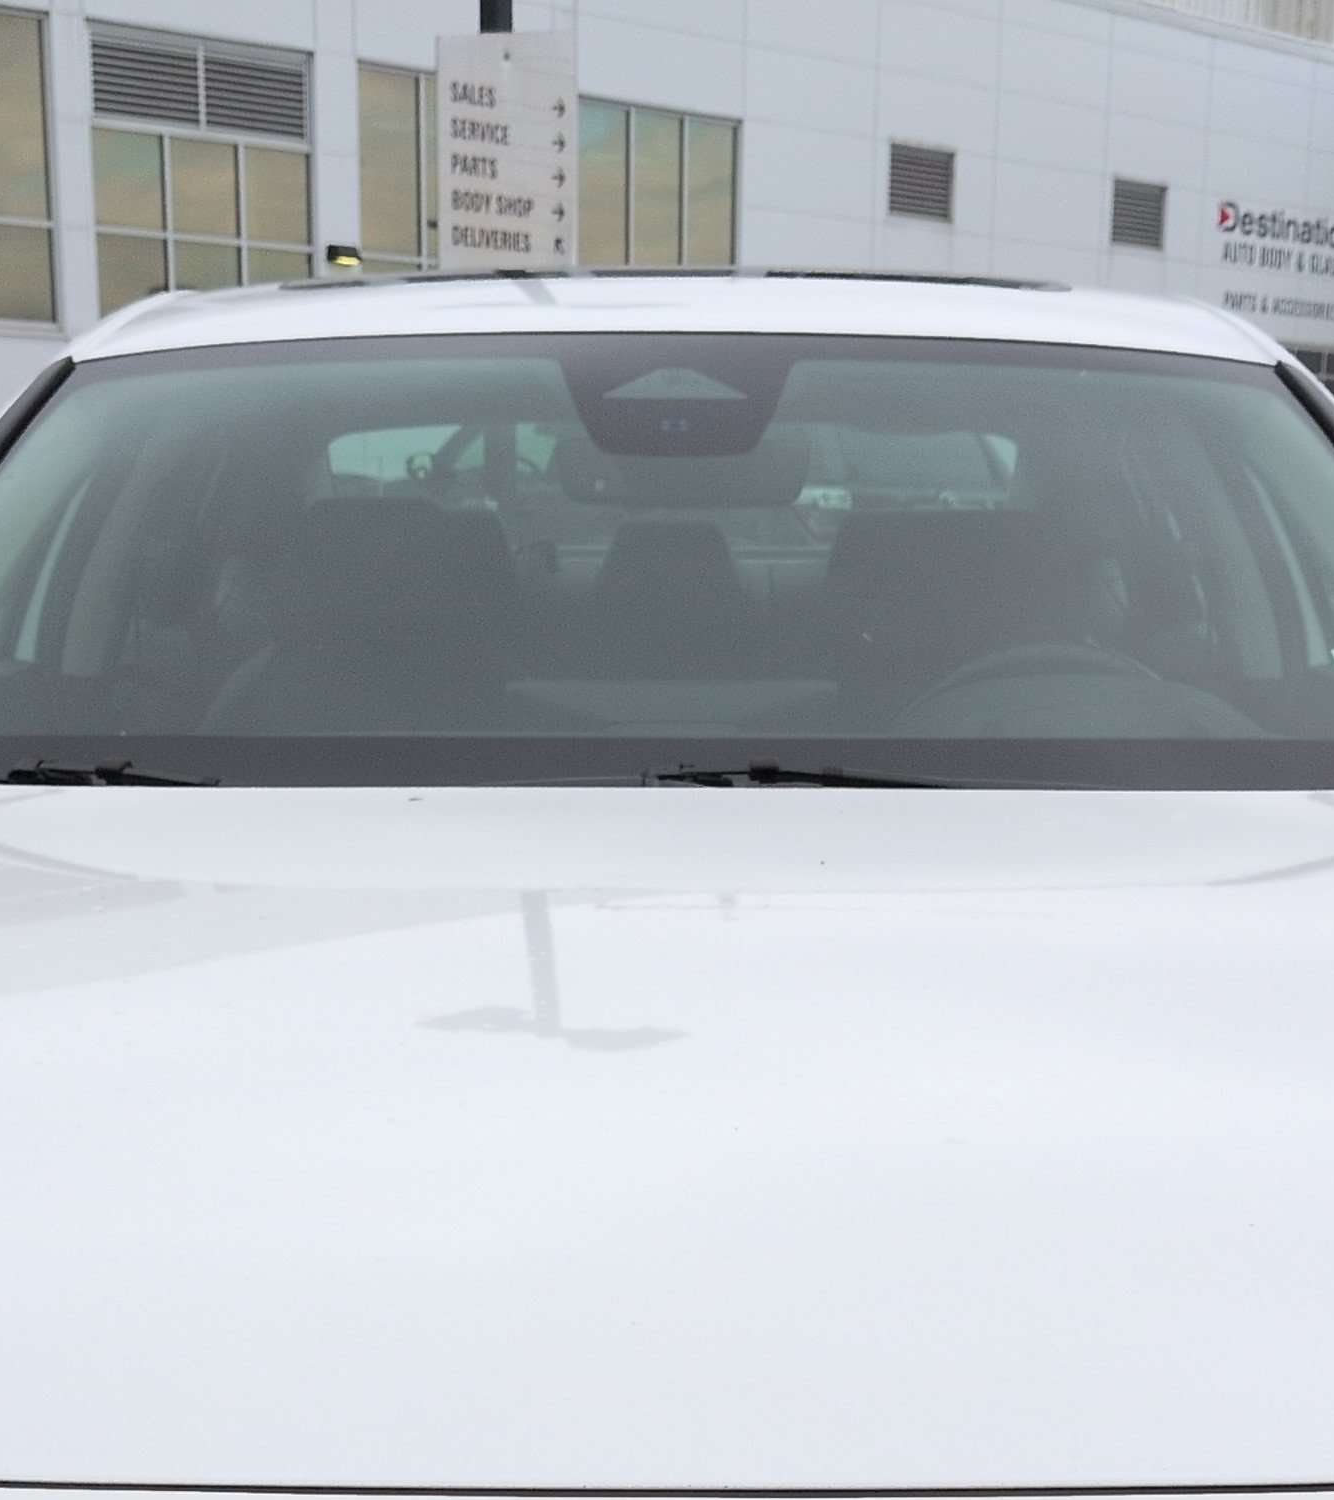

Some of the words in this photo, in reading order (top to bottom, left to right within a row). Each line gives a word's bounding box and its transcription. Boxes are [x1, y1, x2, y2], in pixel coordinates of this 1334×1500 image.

[450, 81, 496, 109] SALES
[450, 117, 510, 146] SERVICE
[450, 153, 498, 180] PARTS
[451, 189, 491, 214] BODY
[495, 195, 535, 218] SHOP
[451, 225, 531, 253] DELIVERIES
[1222, 241, 1254, 266] AUTO
[1258, 245, 1292, 269] BODY
[1223, 290, 1257, 314] PARTS
